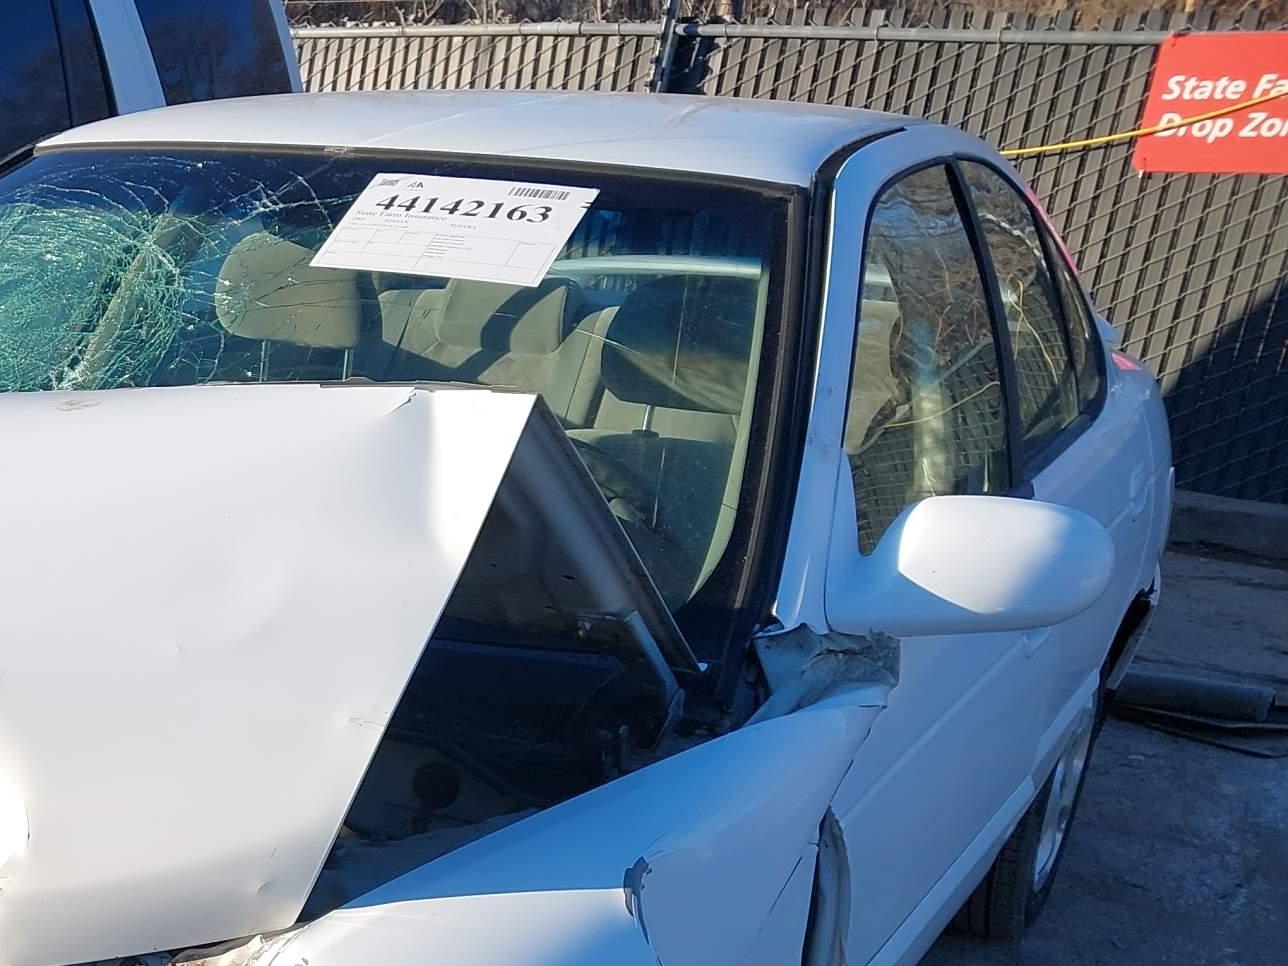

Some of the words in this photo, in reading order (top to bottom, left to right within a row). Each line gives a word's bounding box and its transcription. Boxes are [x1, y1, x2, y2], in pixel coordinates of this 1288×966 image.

[1161, 74, 1247, 100] State
[1153, 112, 1234, 143] Drop
[356, 209, 378, 217] State
[404, 212, 448, 221] Insurance
[375, 193, 553, 223] 44142163
